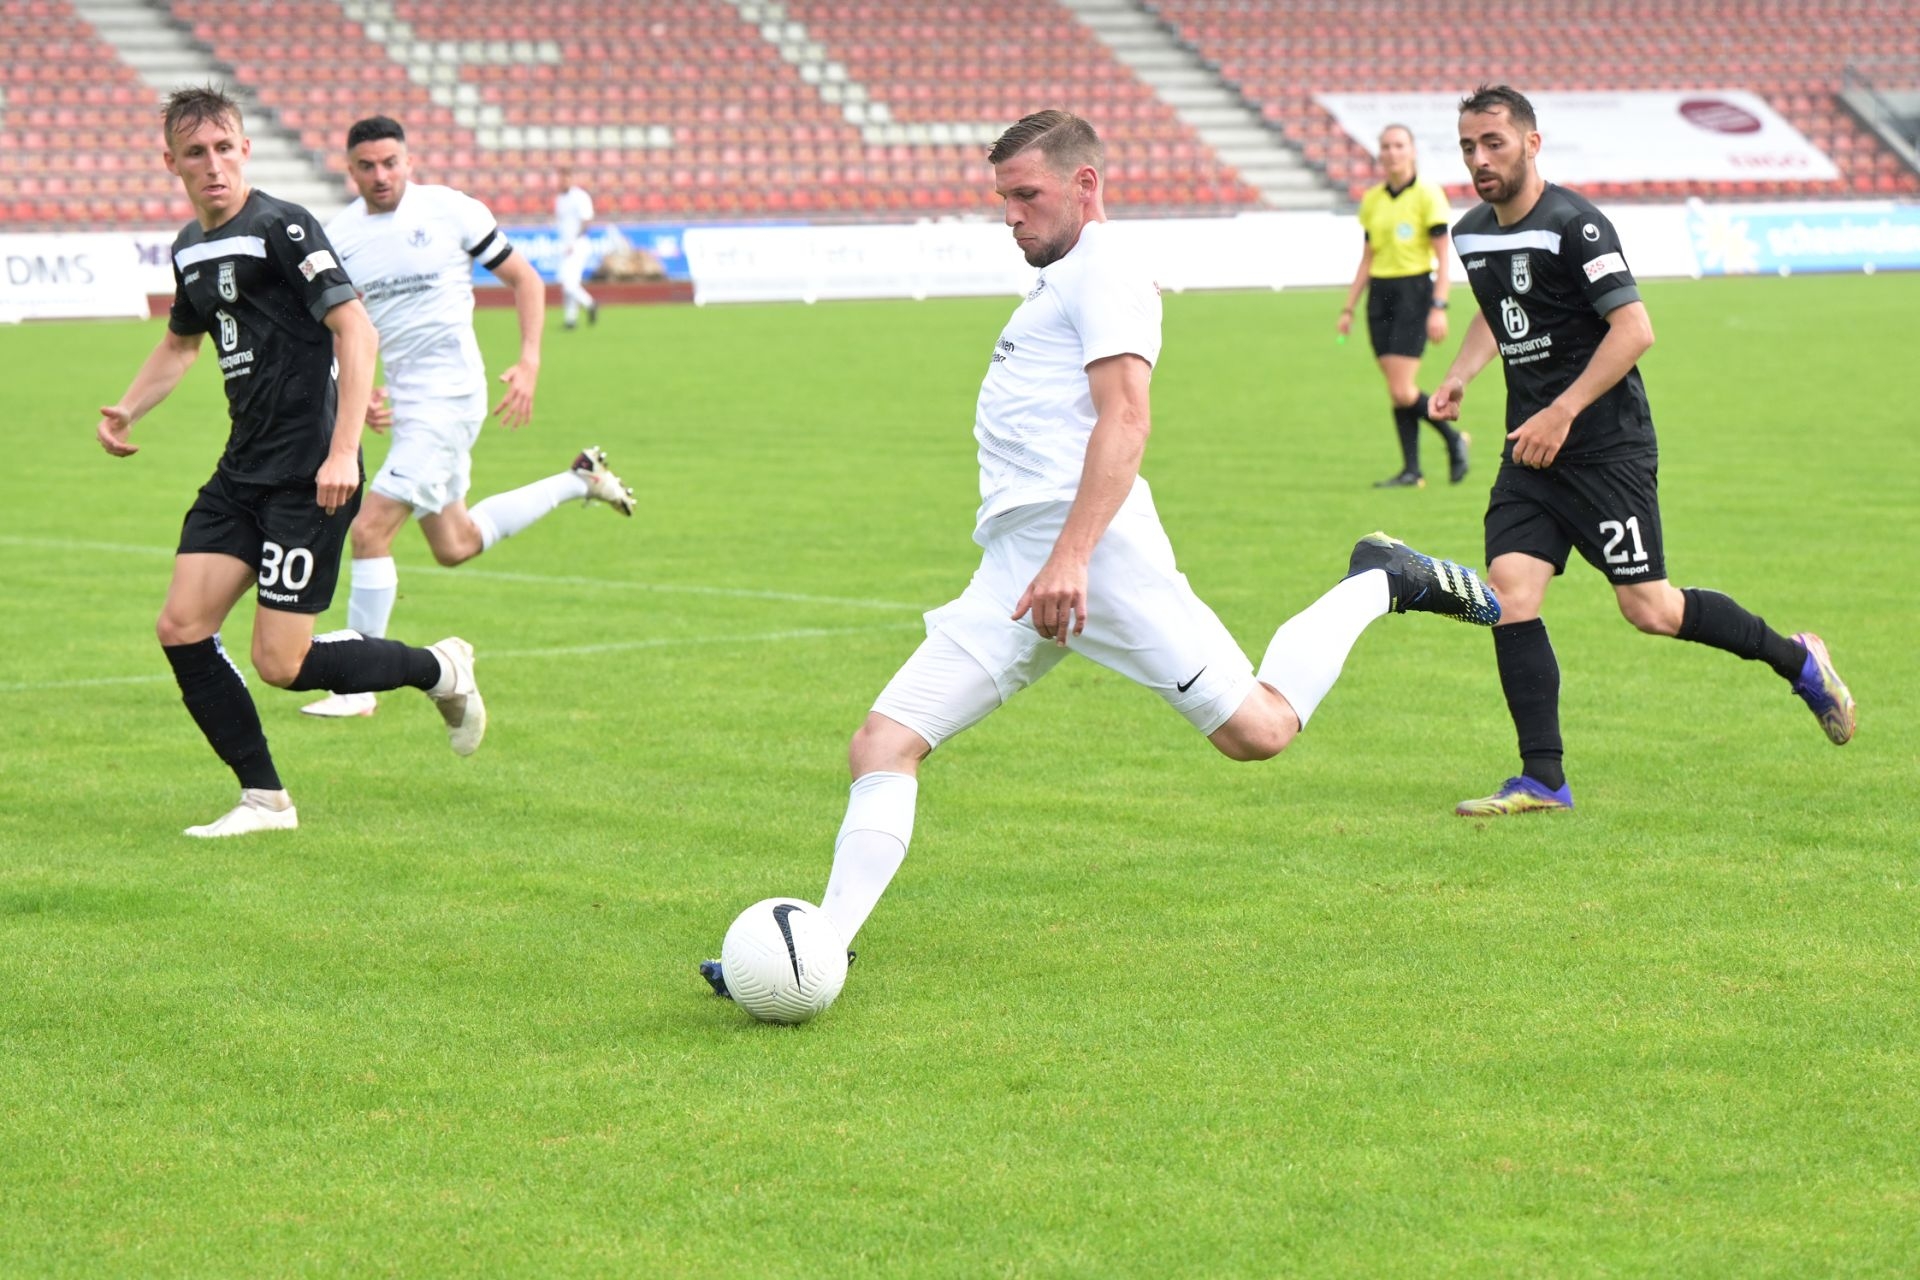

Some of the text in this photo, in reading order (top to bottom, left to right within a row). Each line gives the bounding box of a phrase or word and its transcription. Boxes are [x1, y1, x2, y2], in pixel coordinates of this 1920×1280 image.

[6, 255, 95, 286] DMS
[1599, 516, 1648, 564] 21
[258, 541, 314, 590] 30
[1612, 563, 1650, 576] uhlsport
[259, 588, 298, 603] uhlsport
